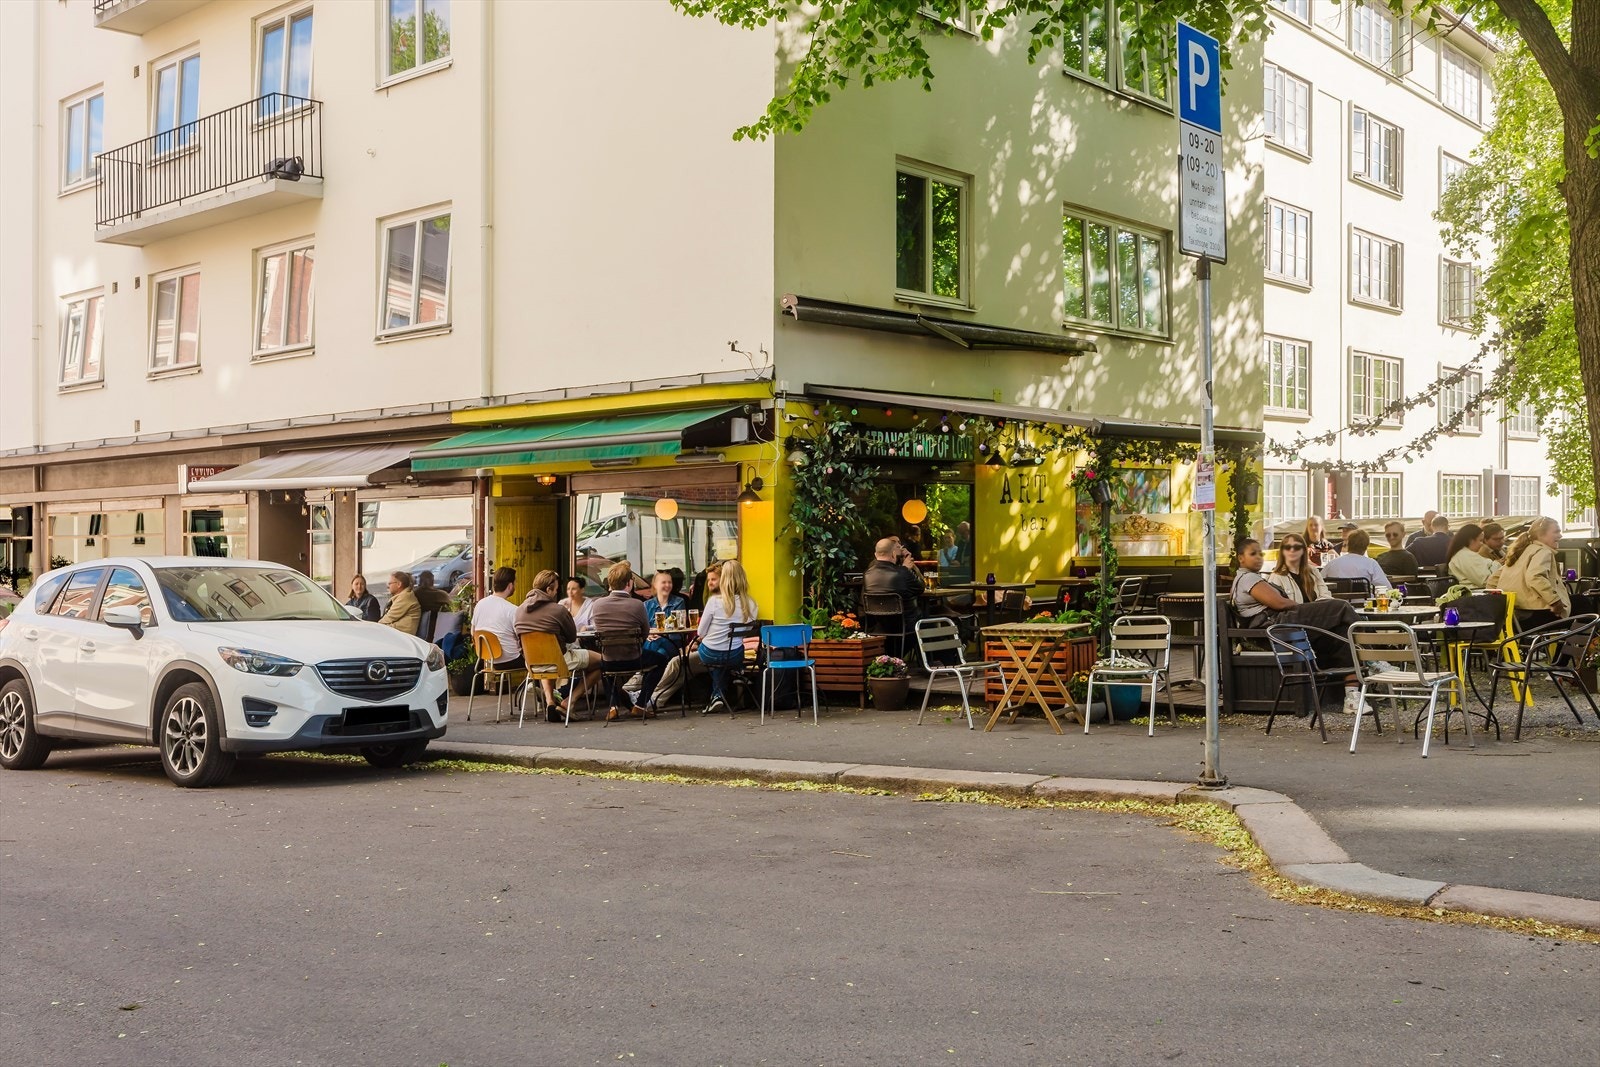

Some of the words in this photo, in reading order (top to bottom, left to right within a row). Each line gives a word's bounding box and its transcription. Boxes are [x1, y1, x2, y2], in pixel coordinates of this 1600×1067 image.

[1188, 40, 1210, 111] P
[913, 432, 934, 458] KIND
[937, 434, 950, 458] OF
[999, 473, 1047, 504] ART
[1020, 513, 1048, 532] bar
